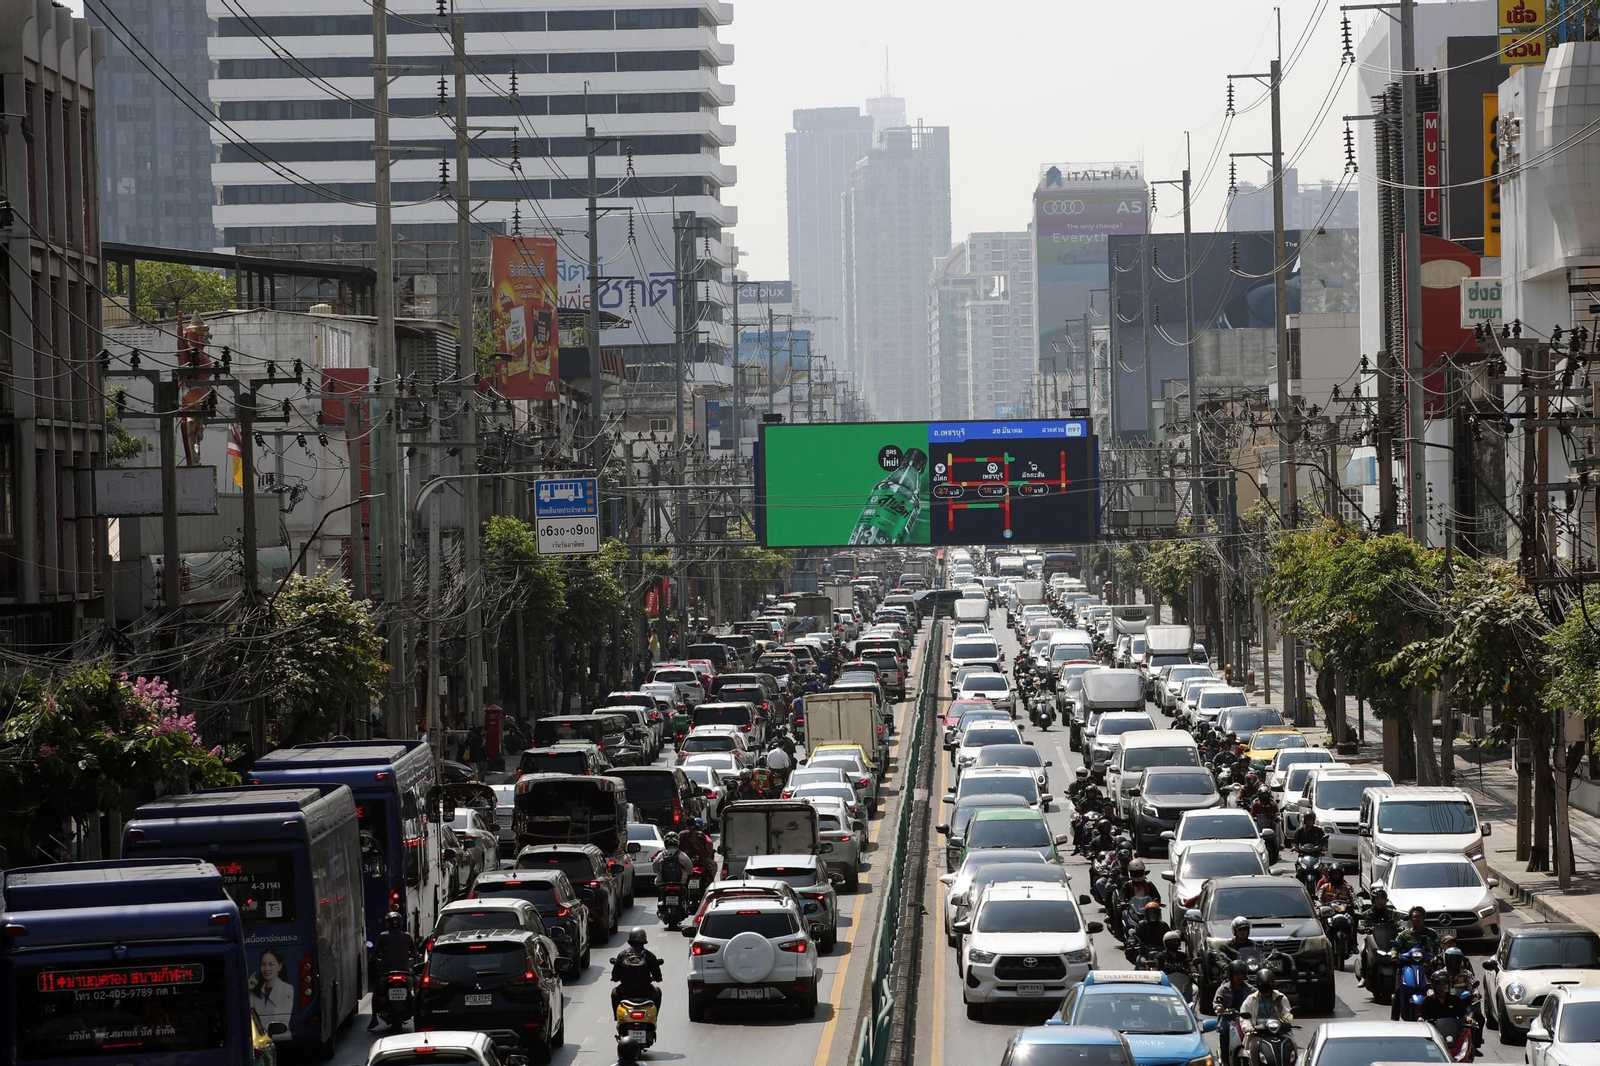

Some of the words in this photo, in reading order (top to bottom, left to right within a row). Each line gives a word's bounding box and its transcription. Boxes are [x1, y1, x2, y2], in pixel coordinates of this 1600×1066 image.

[1425, 118, 1438, 222] MUSIC
[1116, 200, 1142, 214] A5
[1080, 223, 1094, 231] only
[1095, 222, 1123, 231] change?
[1052, 231, 1114, 244] Everyth
[934, 427, 965, 437] ถ.เพชรบุรี
[883, 457, 899, 467] ใหม่!
[540, 524, 595, 537] 0630-0900
[251, 882, 265, 890] 4-3
[74, 990, 90, 1001] โทร
[94, 988, 153, 1000] 02-405-9789
[156, 986, 169, 996] กด
